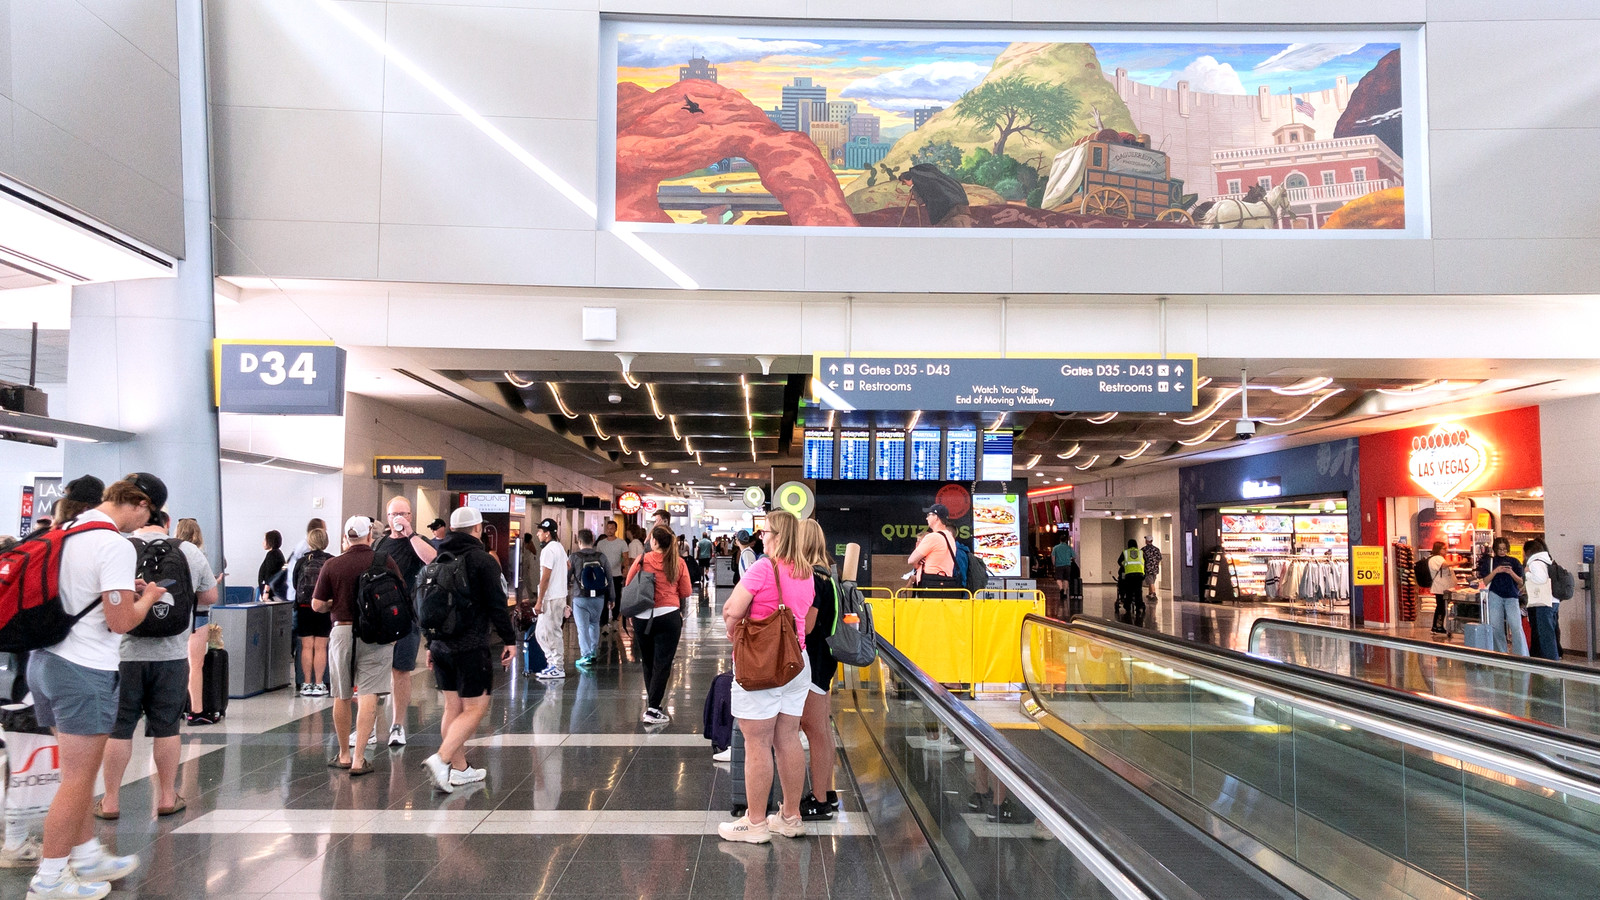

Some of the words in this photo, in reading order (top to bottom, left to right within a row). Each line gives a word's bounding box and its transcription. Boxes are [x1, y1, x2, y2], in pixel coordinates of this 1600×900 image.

[240, 351, 317, 386] D34
[859, 363, 891, 376] Gates
[894, 364, 918, 376] D35
[926, 364, 950, 376] D43
[1060, 364, 1094, 377] Gates
[1096, 365, 1120, 377] D35
[1129, 365, 1154, 377] D43
[859, 380, 912, 392] Restrooms
[972, 385, 998, 394] Watch
[1000, 385, 1018, 394] Your
[1020, 385, 1039, 396] Step
[1099, 381, 1153, 392] Restrooms
[956, 395, 972, 404] End
[973, 395, 983, 404] of
[984, 395, 1015, 406] Moving
[1017, 395, 1055, 407] Walkway
[393, 465, 424, 474] Women
[1418, 462, 1435, 478] LAS
[1438, 458, 1470, 475] VEGAS
[469, 494, 508, 502] SOUND
[670, 504, 686, 513] D36
[881, 523, 971, 541] QUIZS
[1443, 522, 1475, 534] GEA
